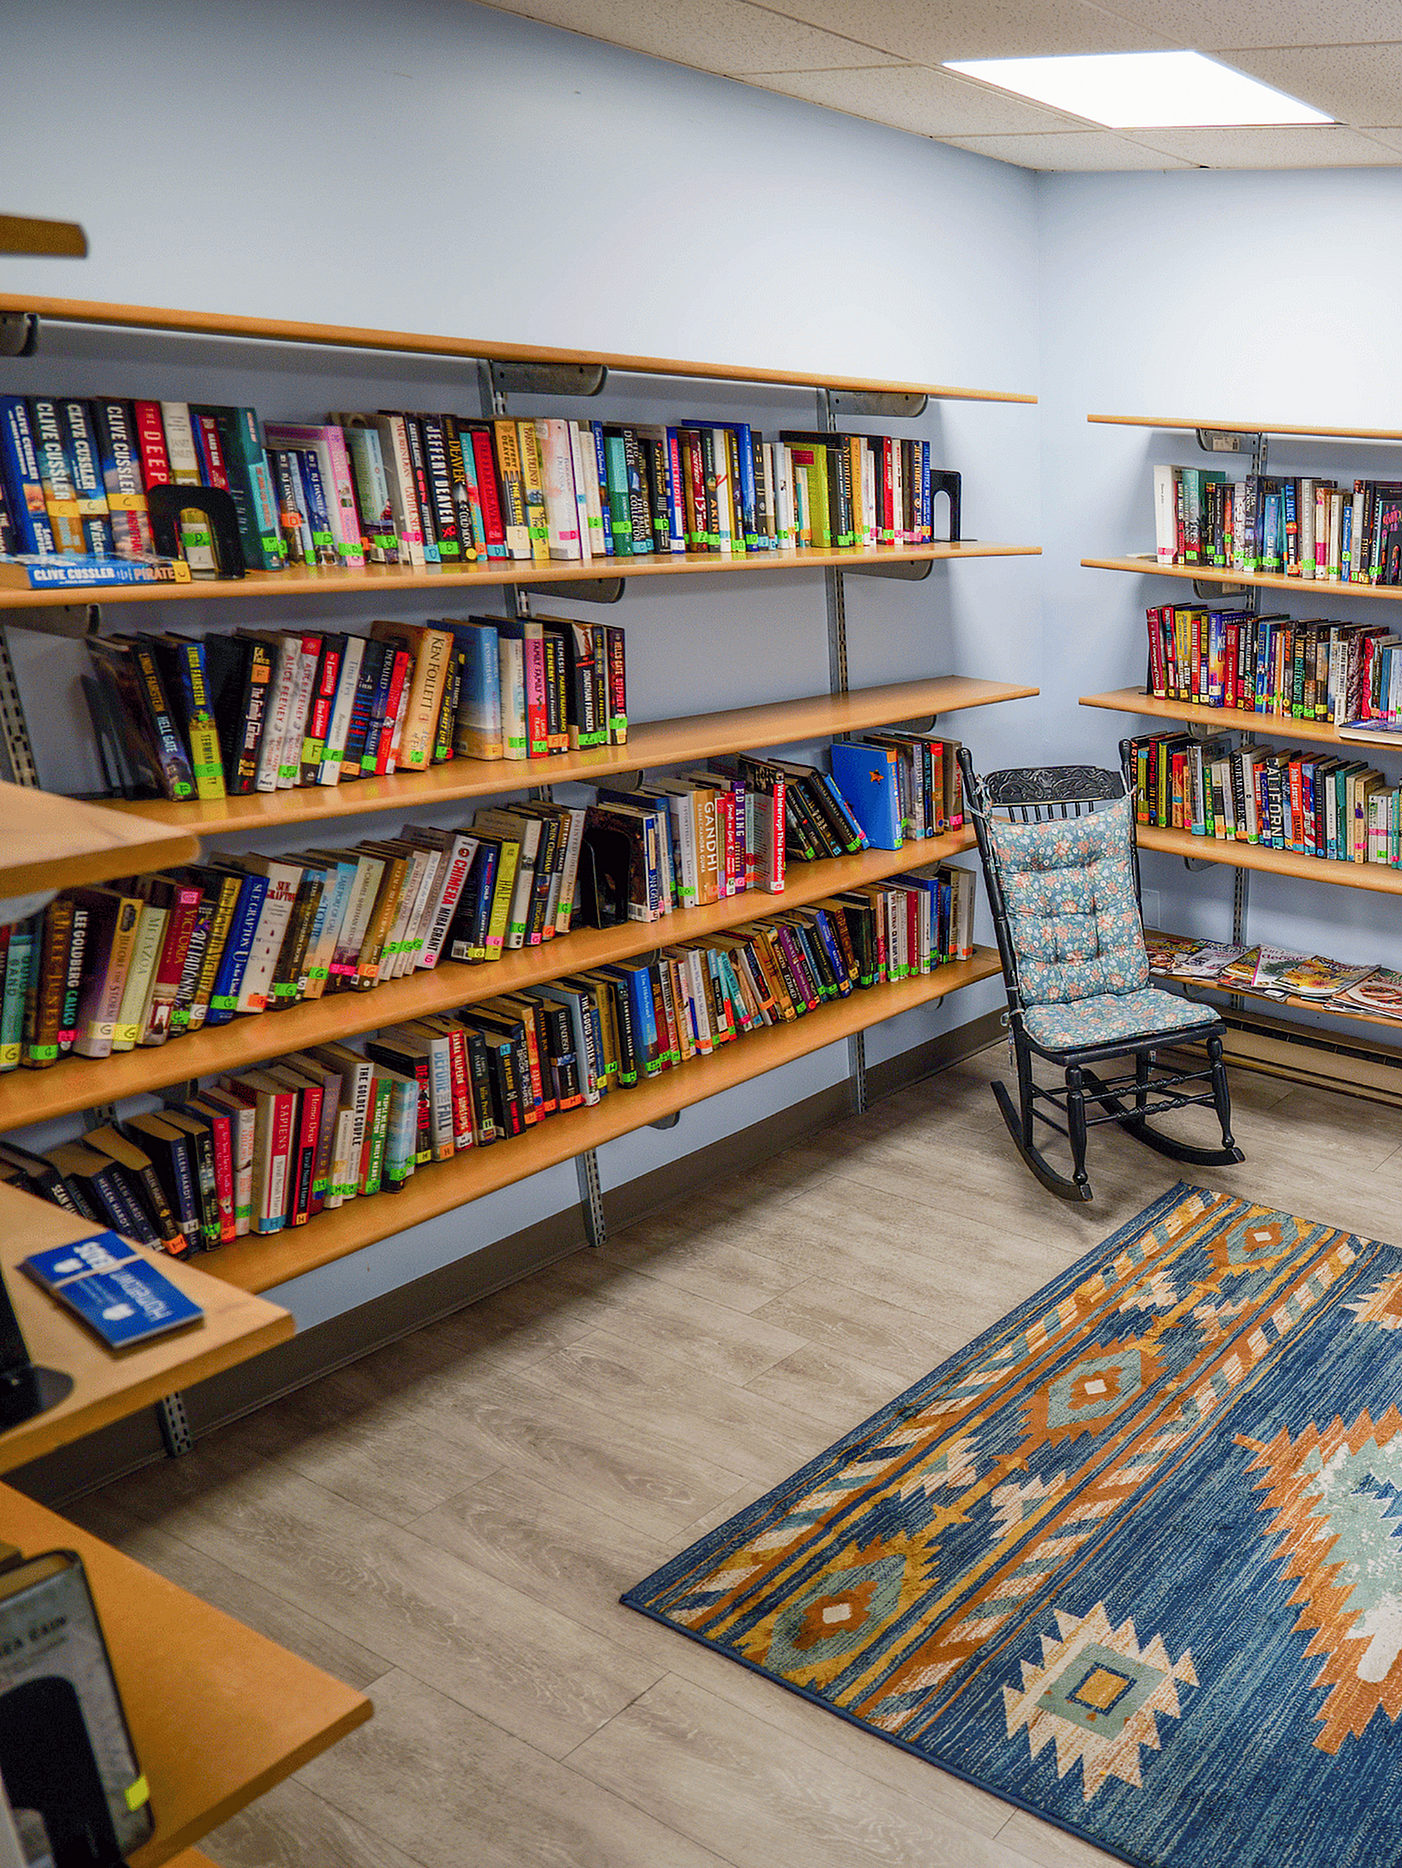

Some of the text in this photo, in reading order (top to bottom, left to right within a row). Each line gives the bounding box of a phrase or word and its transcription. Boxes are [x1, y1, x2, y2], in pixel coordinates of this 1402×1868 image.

[16, 406, 29, 440] CLIVE
[67, 404, 96, 490] CLIVE CUSSLER
[22, 438, 39, 480] CUSSLER
[36, 403, 71, 500] CLIVE CUSSLER
[106, 406, 136, 495] CLIVE CUSSLER
[144, 431, 168, 483] DEEP
[449, 440, 466, 483] DEAVER
[501, 435, 511, 468] DEAVER
[508, 434, 518, 468] JEFFERY
[624, 430, 635, 466] DEKKER
[426, 427, 454, 524] JEFFERY DEAVER
[710, 499, 719, 533] AKIN
[1286, 498, 1294, 521] JANCE
[33, 567, 115, 581] CLIVE CUSSLER
[133, 565, 175, 581] PIRATE
[186, 646, 207, 706] LINDA FAIRSTEIN
[379, 649, 394, 690] DERAILED
[421, 636, 445, 709] KEN FOLLETT
[546, 643, 555, 683] FRENEMY
[275, 654, 295, 722] ALICE FEENEY
[294, 661, 312, 721] ALICE FEENEY
[583, 669, 595, 732] JONATHAN FRANZEN
[157, 715, 178, 753] HELL GATE
[1233, 757, 1244, 800] NORMAN
[1290, 767, 1300, 811] John Lescroart
[548, 820, 559, 838] JOHN
[704, 801, 719, 872] GANDHI
[735, 788, 745, 837] ED KING
[1293, 814, 1301, 841] DAMAGE
[240, 883, 262, 947] SUE GRAFTON
[311, 905, 328, 938] TOUR
[426, 858, 468, 952] CHIMERA MIRA GRANT
[67, 911, 89, 987] LEE GOLDBERG
[174, 909, 198, 964] VICTORIA
[62, 990, 78, 1025] CALICO
[581, 995, 596, 1065] THE GOOD SISTER
[309, 1093, 321, 1121] Homo
[351, 1066, 370, 1147] THE GOLDEN COUPLE
[433, 1051, 452, 1131] BEFORE FALL
[276, 1104, 290, 1151] SAPIENS
[112, 1172, 144, 1222] HELEN HARDT
[177, 1146, 192, 1200] HELEN HARDT
[98, 1177, 130, 1228] HELEN HARDT
